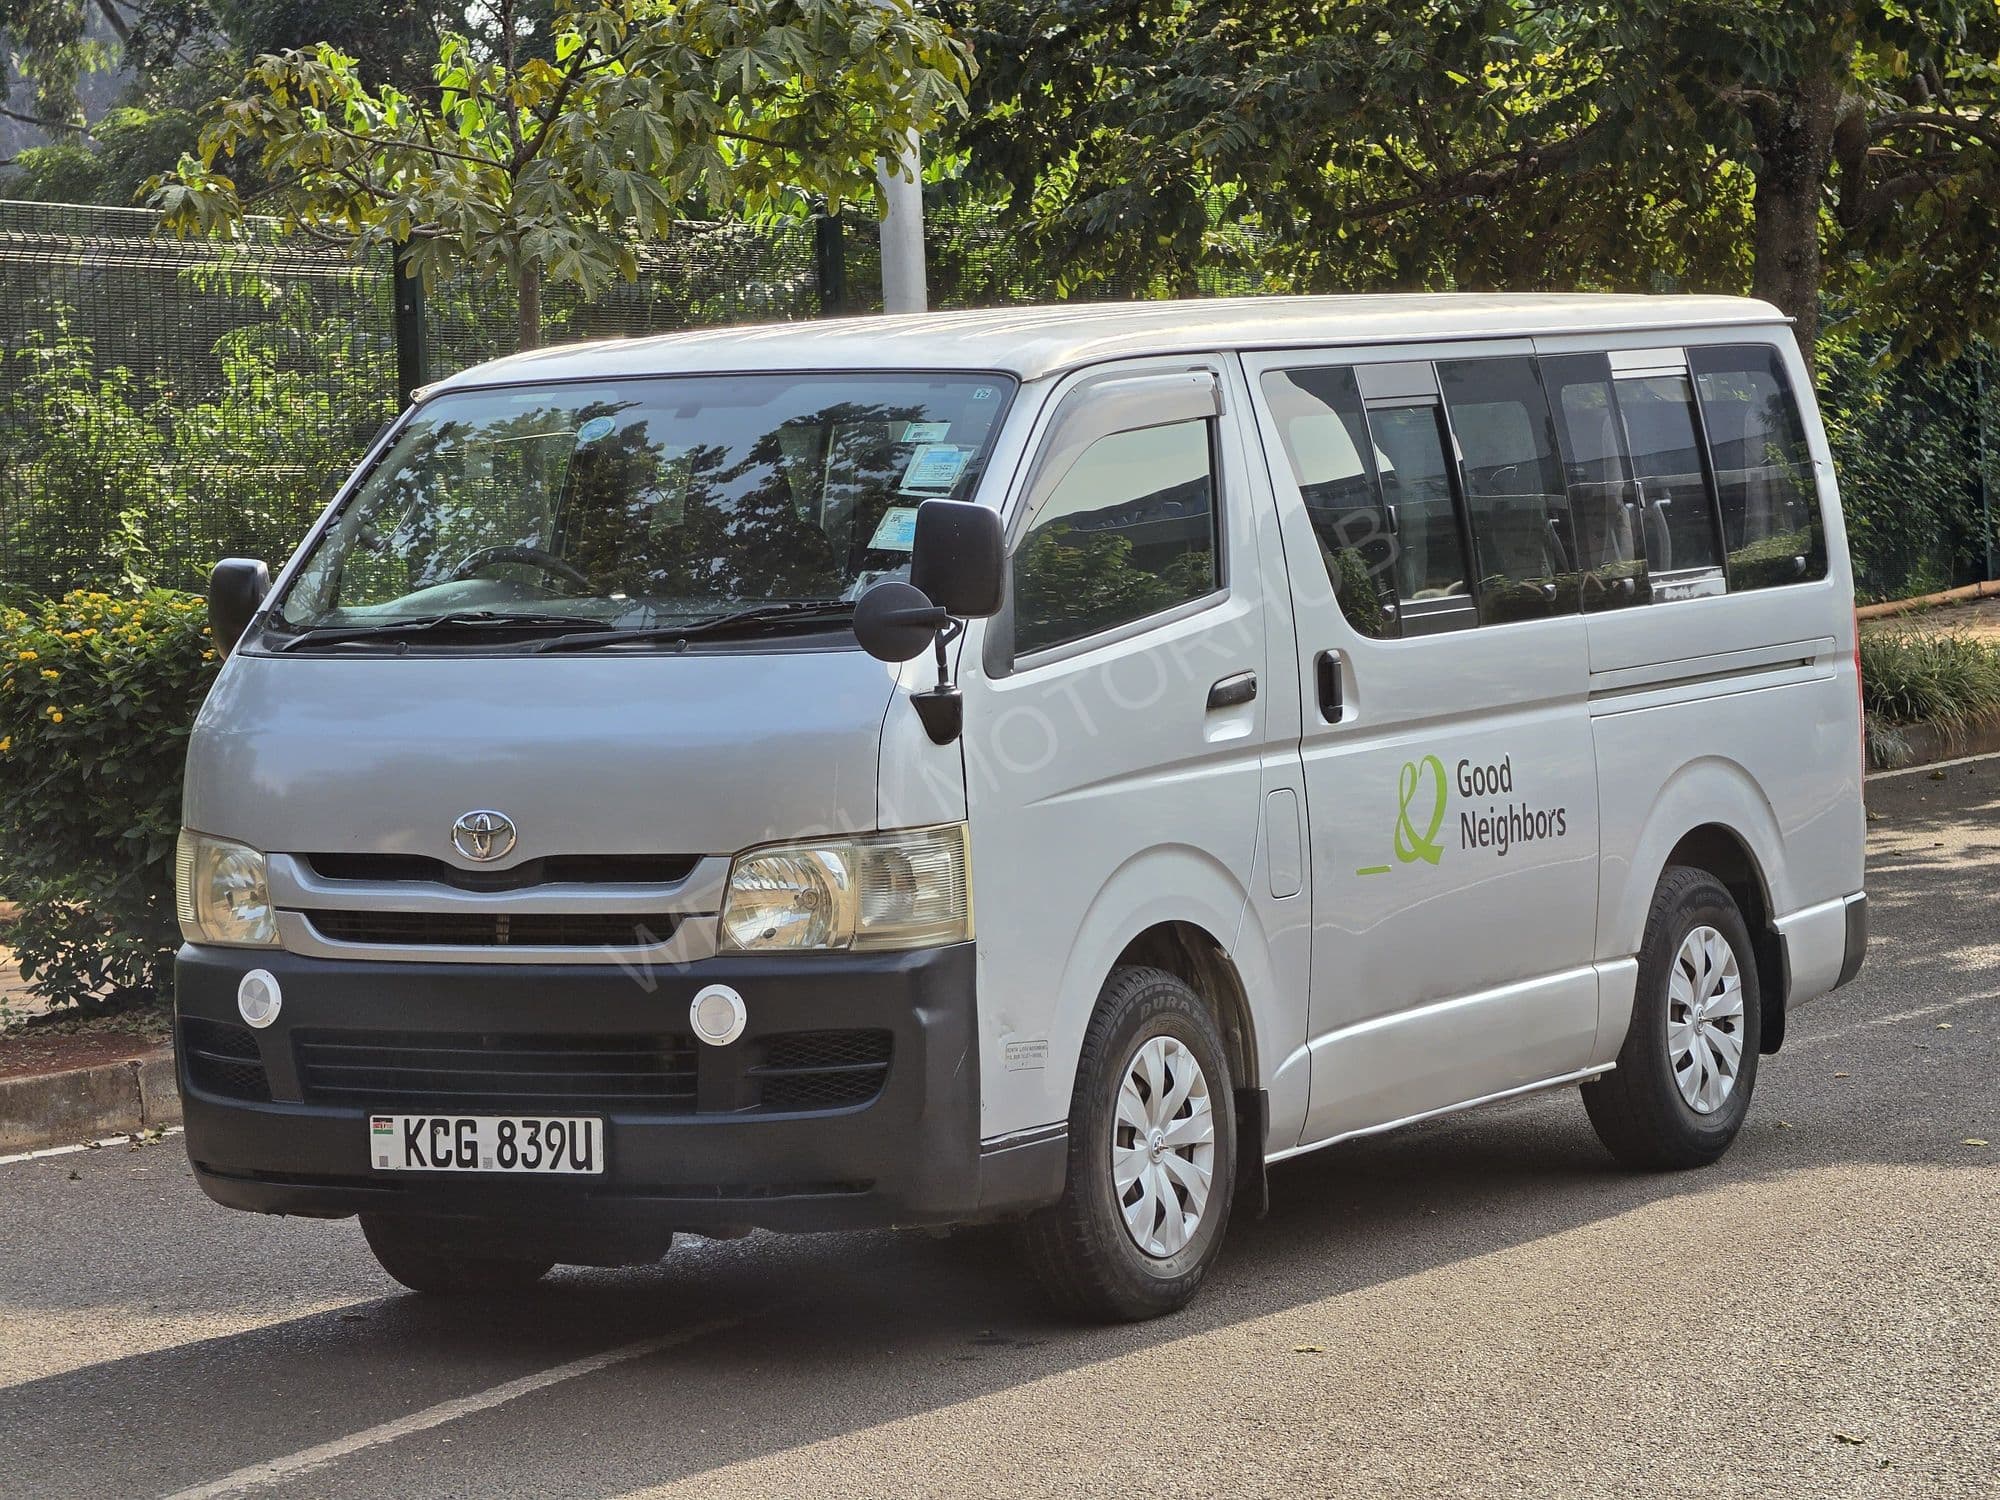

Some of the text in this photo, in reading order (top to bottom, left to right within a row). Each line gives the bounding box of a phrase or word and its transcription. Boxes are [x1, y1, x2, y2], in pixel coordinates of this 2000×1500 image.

[1456, 752, 1513, 798] Good
[1460, 802, 1567, 857] Neighbors
[403, 1118, 593, 1171] KCG 839U
